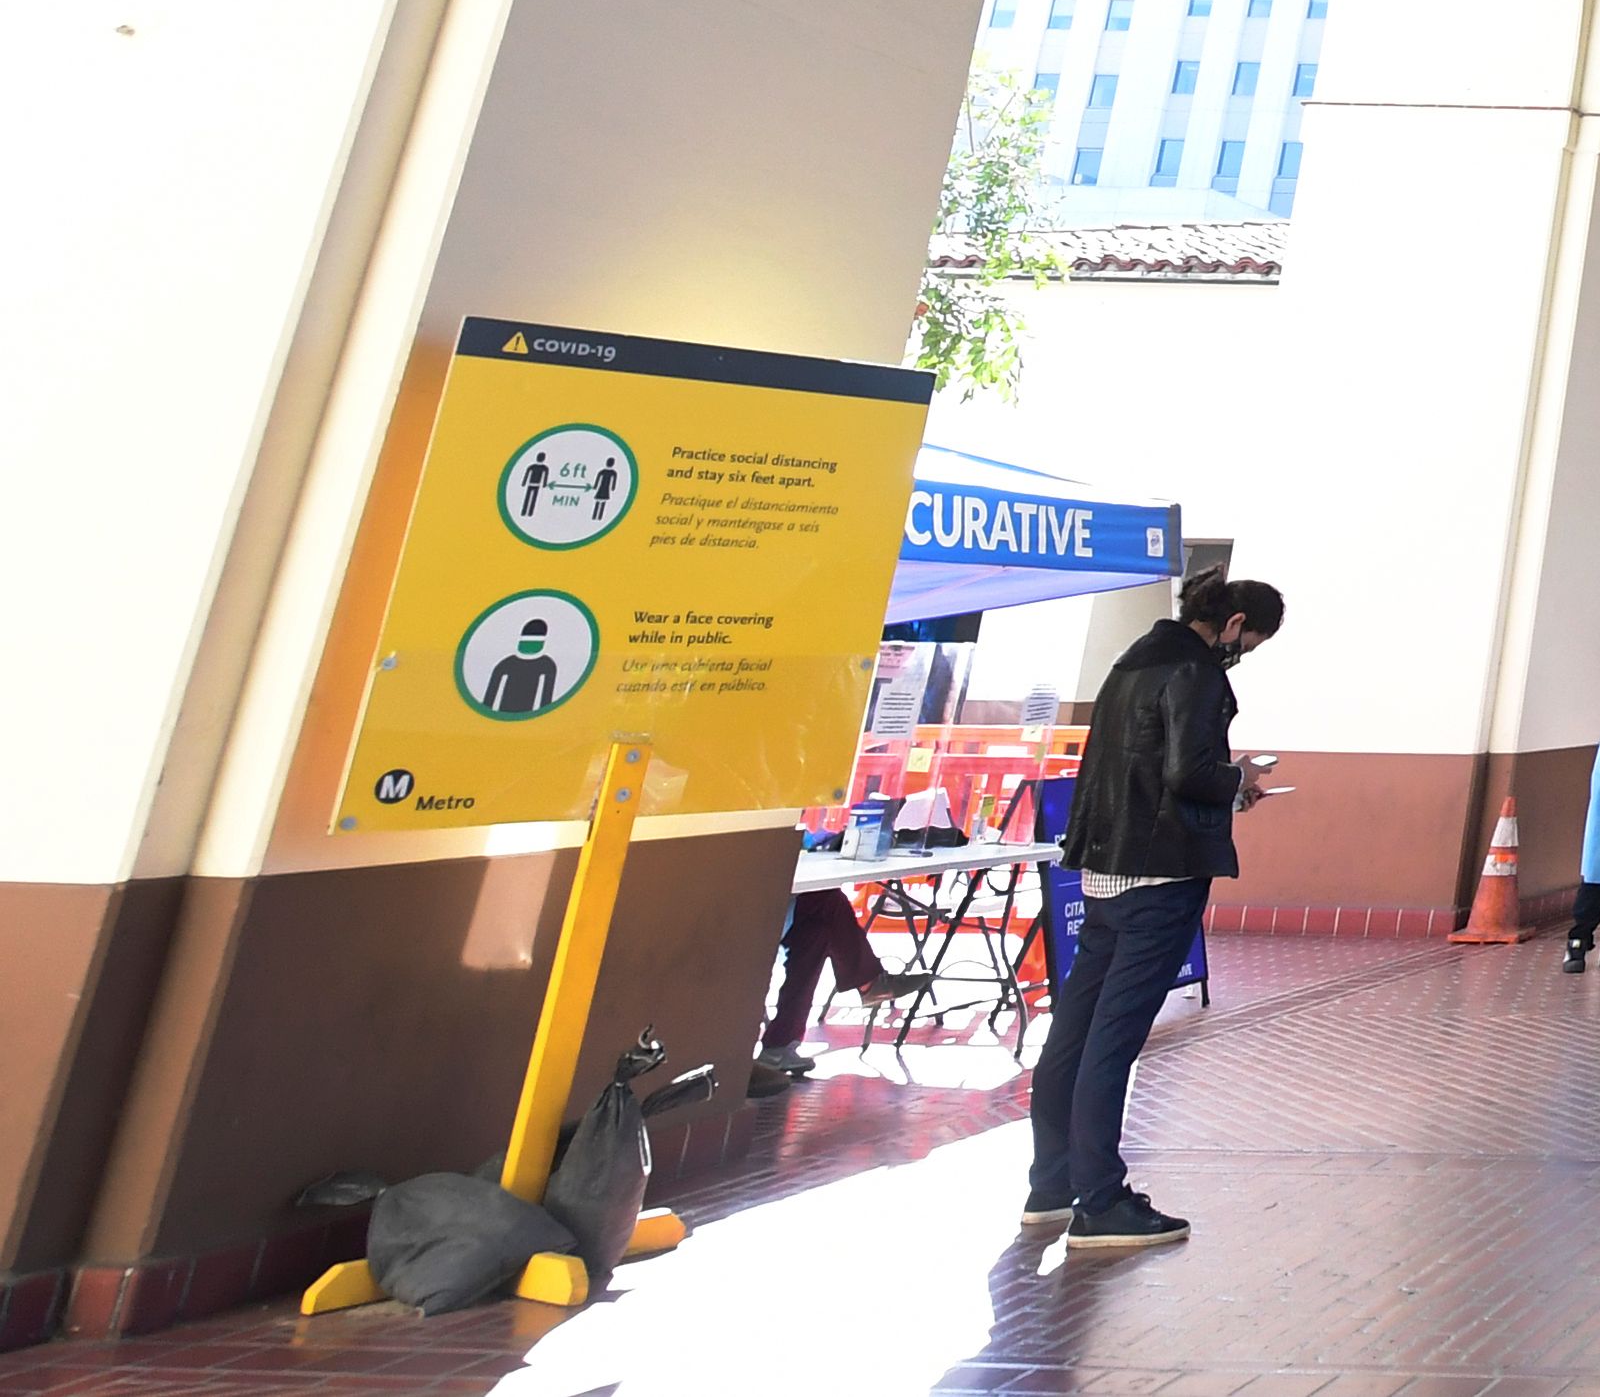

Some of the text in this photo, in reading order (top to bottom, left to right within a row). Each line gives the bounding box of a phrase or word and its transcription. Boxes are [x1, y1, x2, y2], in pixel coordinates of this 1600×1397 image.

[533, 339, 616, 362] COVID-19
[672, 447, 837, 473] Practice social distancing
[667, 467, 815, 489] and stay six feet apart.
[552, 495, 580, 506] MIN
[661, 492, 839, 515] Practique el distanciamiento
[655, 514, 820, 533] social y manténgase a seis
[904, 490, 1093, 558] CURATIVE
[649, 532, 759, 549] pies de distancia.
[633, 611, 774, 629] Wear a face covering
[629, 631, 733, 647] while in public.
[733, 658, 773, 675] facial
[616, 681, 667, 692] cuando
[700, 682, 715, 692] en
[379, 774, 475, 811] M Metro
[1064, 900, 1086, 918] CITA
